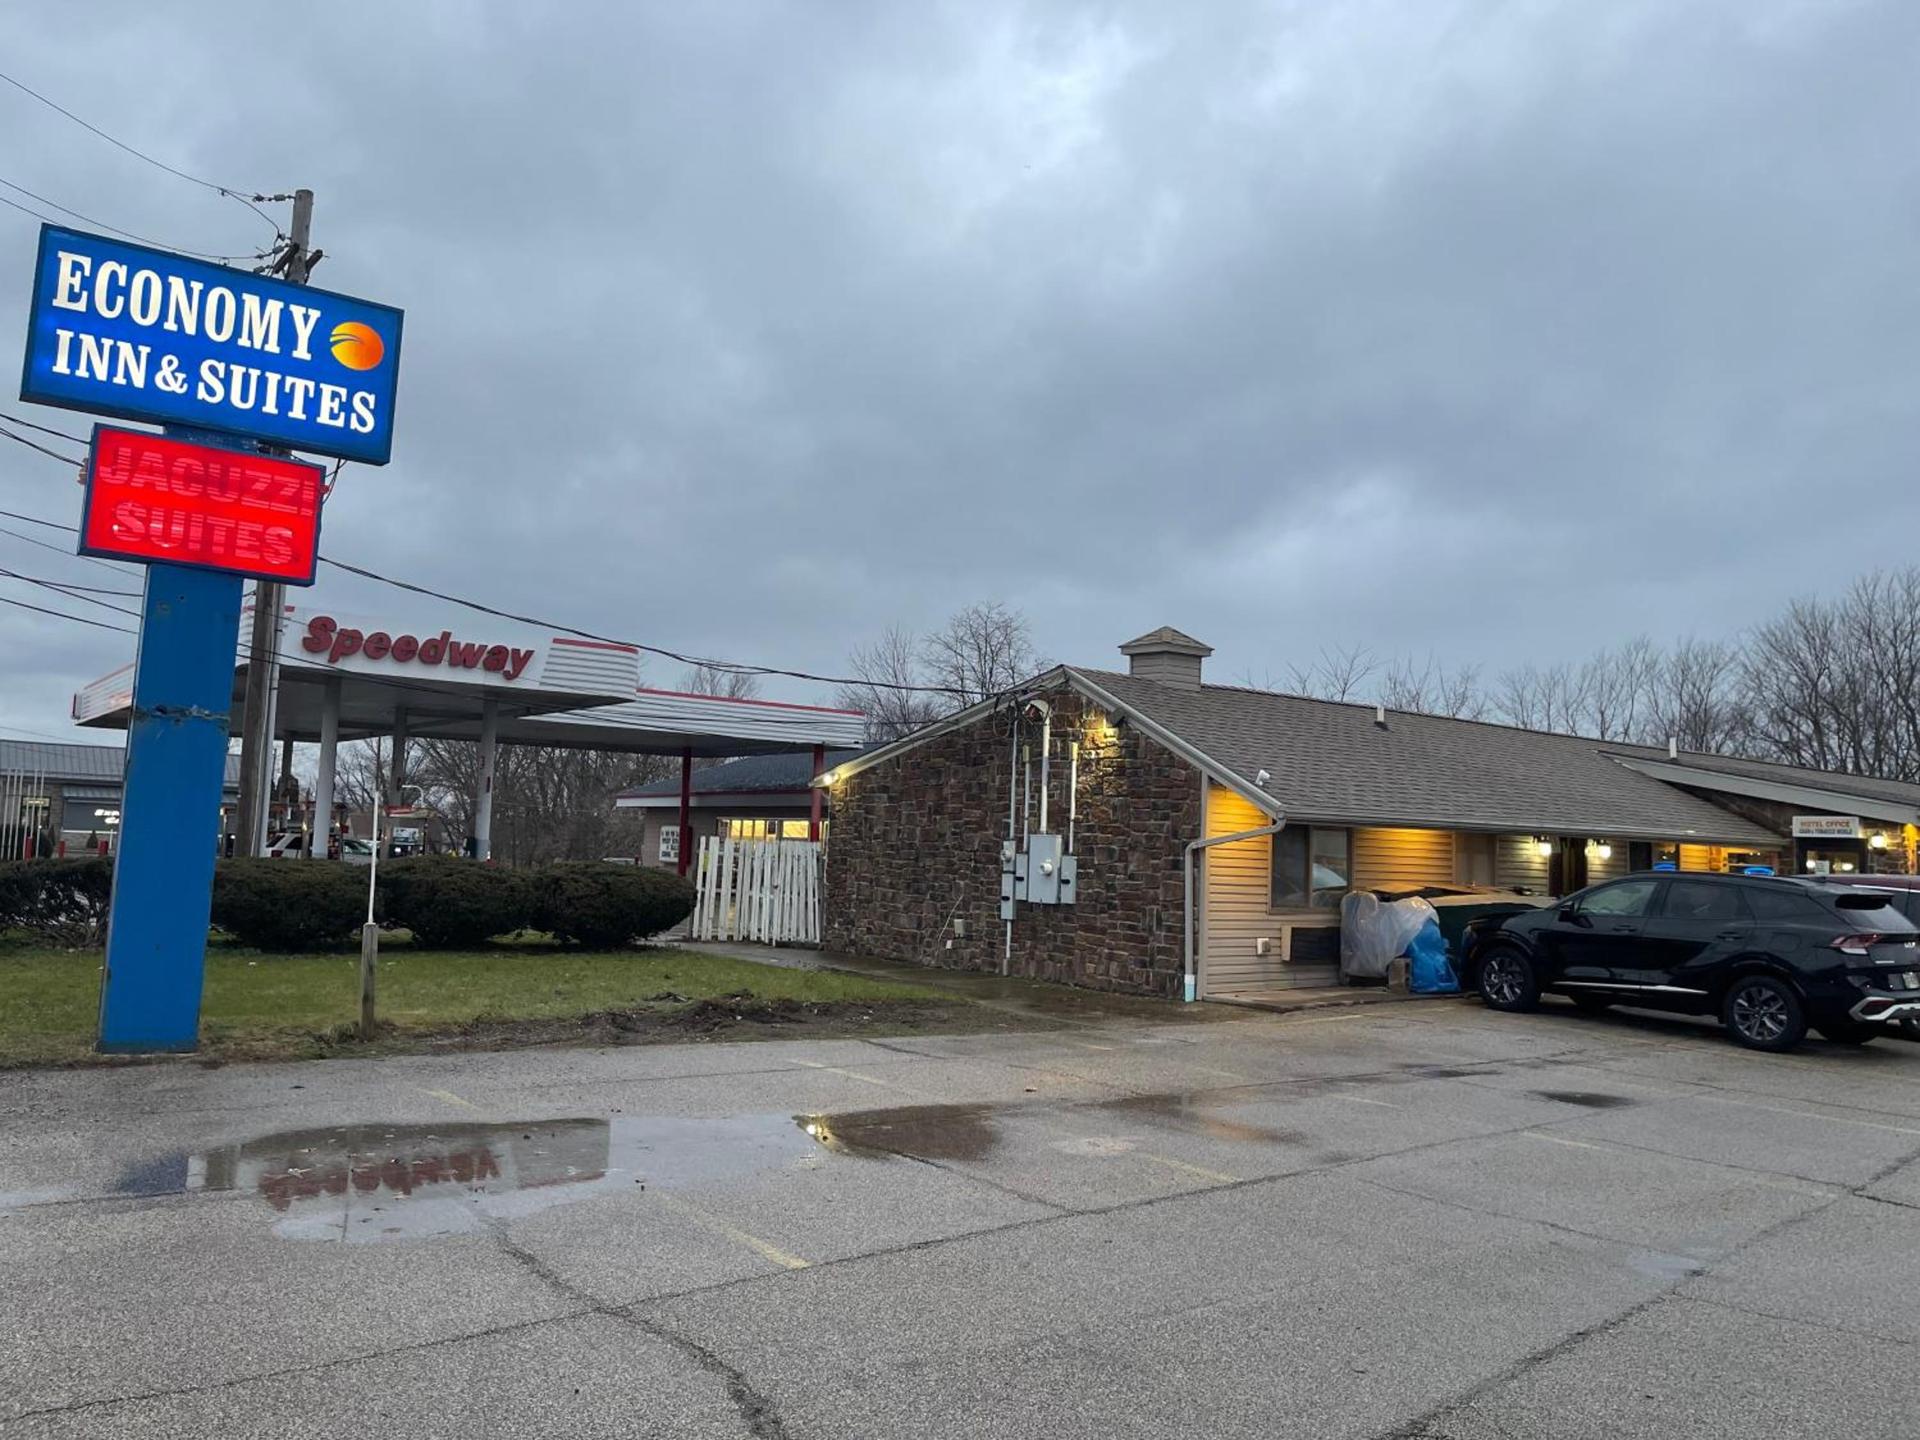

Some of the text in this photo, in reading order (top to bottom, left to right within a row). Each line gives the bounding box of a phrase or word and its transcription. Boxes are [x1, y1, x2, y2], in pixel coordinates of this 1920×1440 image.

[52, 250, 321, 361] ECONOMY
[52, 328, 376, 433] INN & SUITES
[99, 447, 315, 516] JACUZZI
[112, 501, 293, 565] SUITES
[302, 616, 535, 681] Speedway
